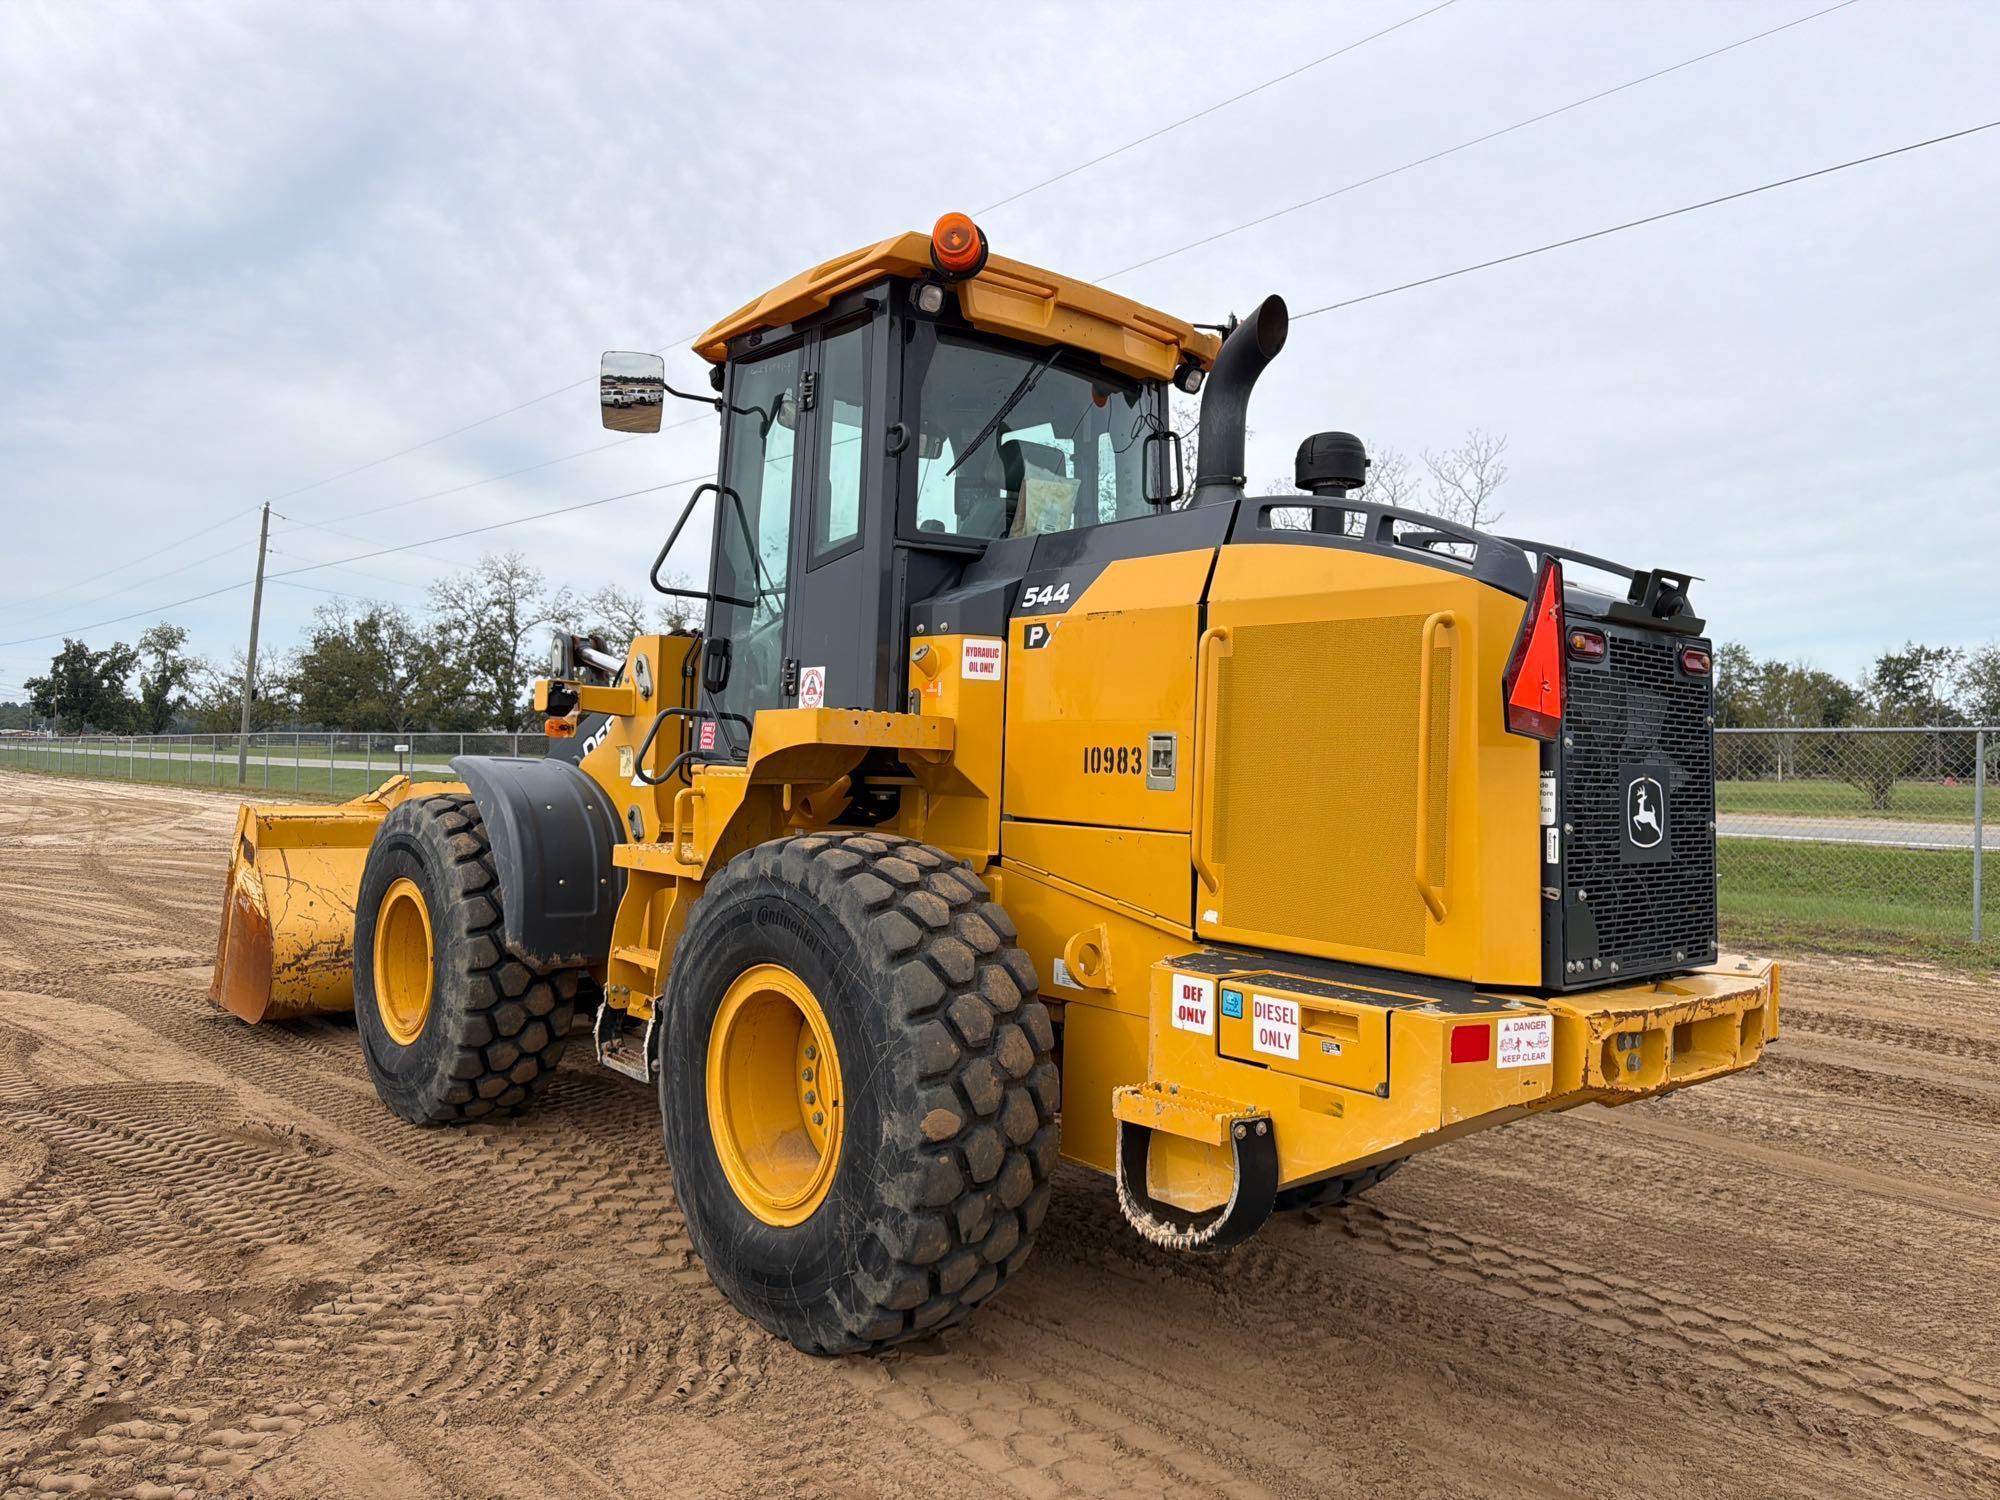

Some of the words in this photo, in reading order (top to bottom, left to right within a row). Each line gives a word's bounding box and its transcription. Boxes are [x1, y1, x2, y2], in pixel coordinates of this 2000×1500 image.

[1022, 583, 1070, 608] 544
[1029, 626, 1043, 646] P
[965, 646, 999, 659] HYDRAULIC
[969, 662, 979, 673] OIL
[980, 662, 994, 673] ONLY
[1084, 747, 1142, 775] 10983
[758, 906, 819, 953] Continental
[1183, 985, 1203, 1003] DEF
[1179, 1005, 1206, 1025] ONLY
[1254, 1002, 1297, 1026] DIESEL
[1513, 1021, 1547, 1031] DANGER
[1260, 1028, 1291, 1050] ONLY
[1502, 1055, 1521, 1063] KEEP
[1522, 1052, 1546, 1061] CLEAR
